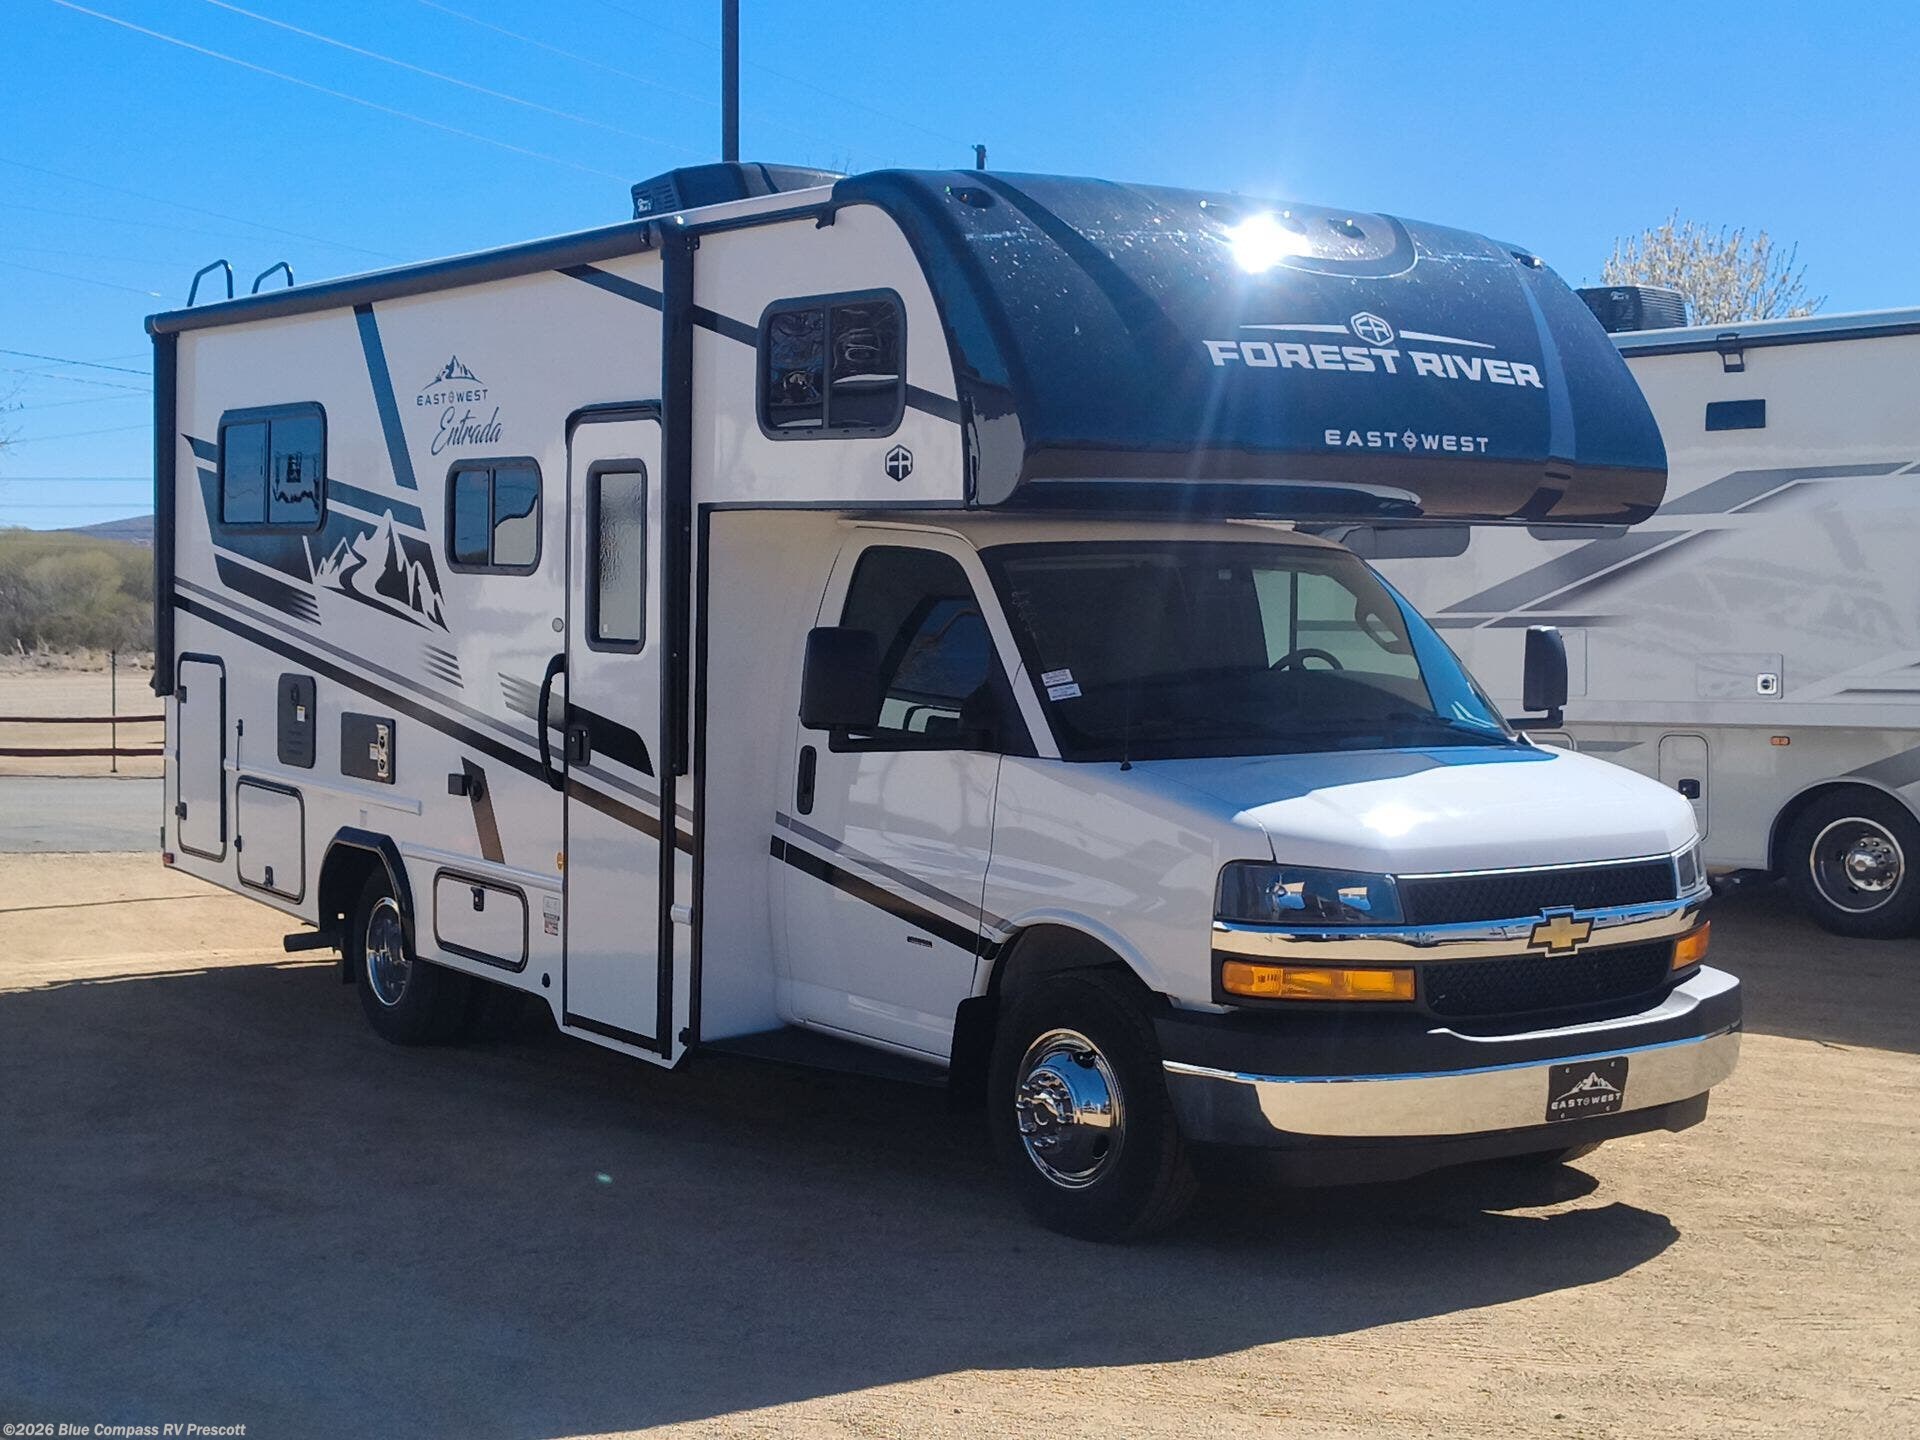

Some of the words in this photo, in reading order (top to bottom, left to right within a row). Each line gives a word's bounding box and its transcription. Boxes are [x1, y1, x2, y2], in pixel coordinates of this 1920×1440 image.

[1202, 340, 1400, 374] FOREST
[1408, 350, 1544, 389] RIVER
[416, 393, 446, 407] EAST
[456, 389, 488, 403] WEST
[431, 406, 502, 456] Entrada
[1324, 429, 1398, 448] EAST
[1421, 434, 1489, 453] WEST
[1551, 1098, 1583, 1110] EAST
[1591, 1092, 1622, 1105] WEST
